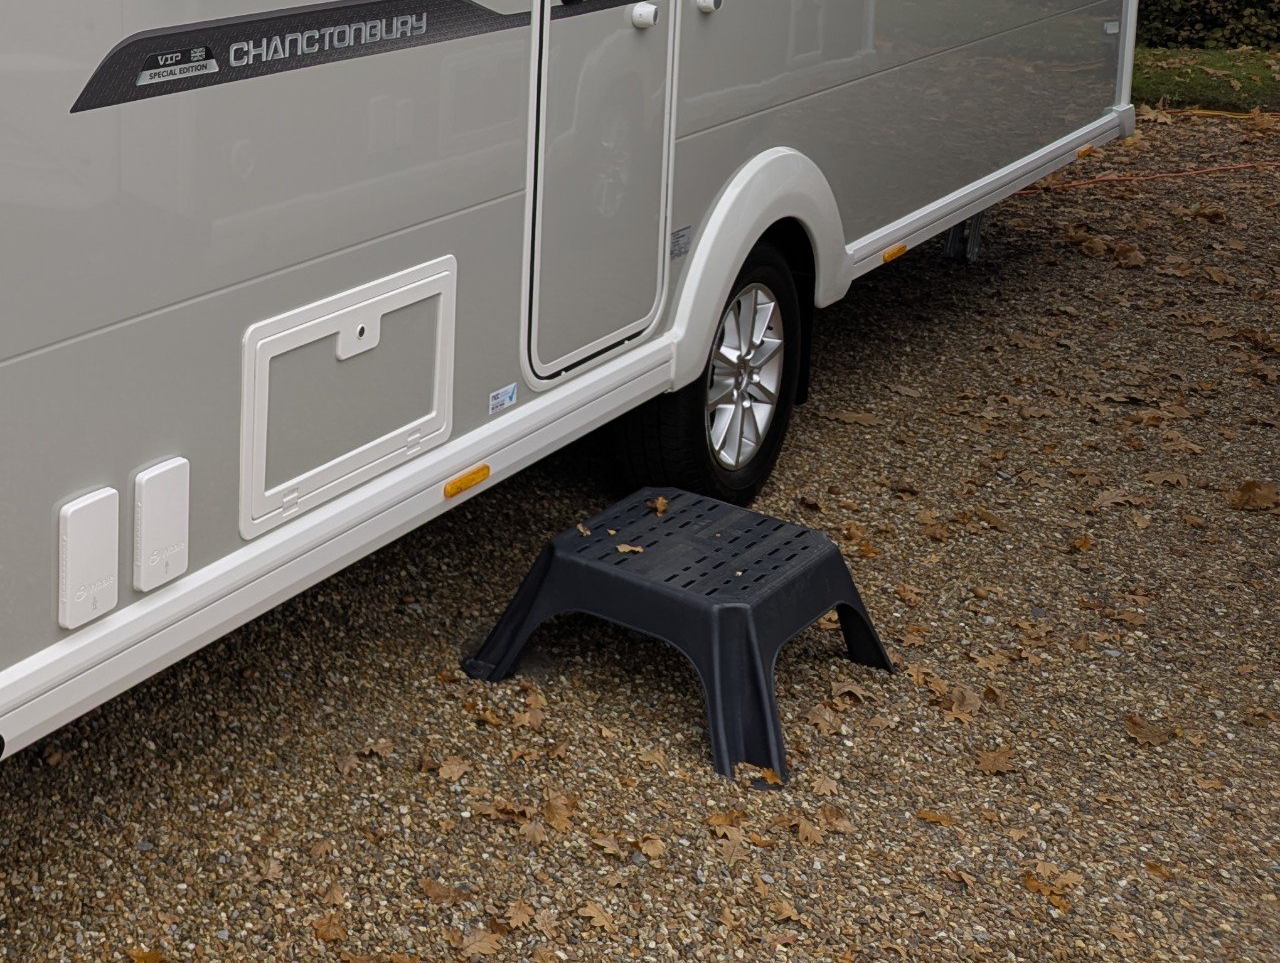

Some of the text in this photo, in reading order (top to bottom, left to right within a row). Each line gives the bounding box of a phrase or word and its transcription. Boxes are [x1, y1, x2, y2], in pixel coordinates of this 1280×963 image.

[229, 12, 428, 67] CHANCTONBURY
[158, 53, 181, 65] VIP
[149, 63, 208, 80] SPECIAL EDITION
